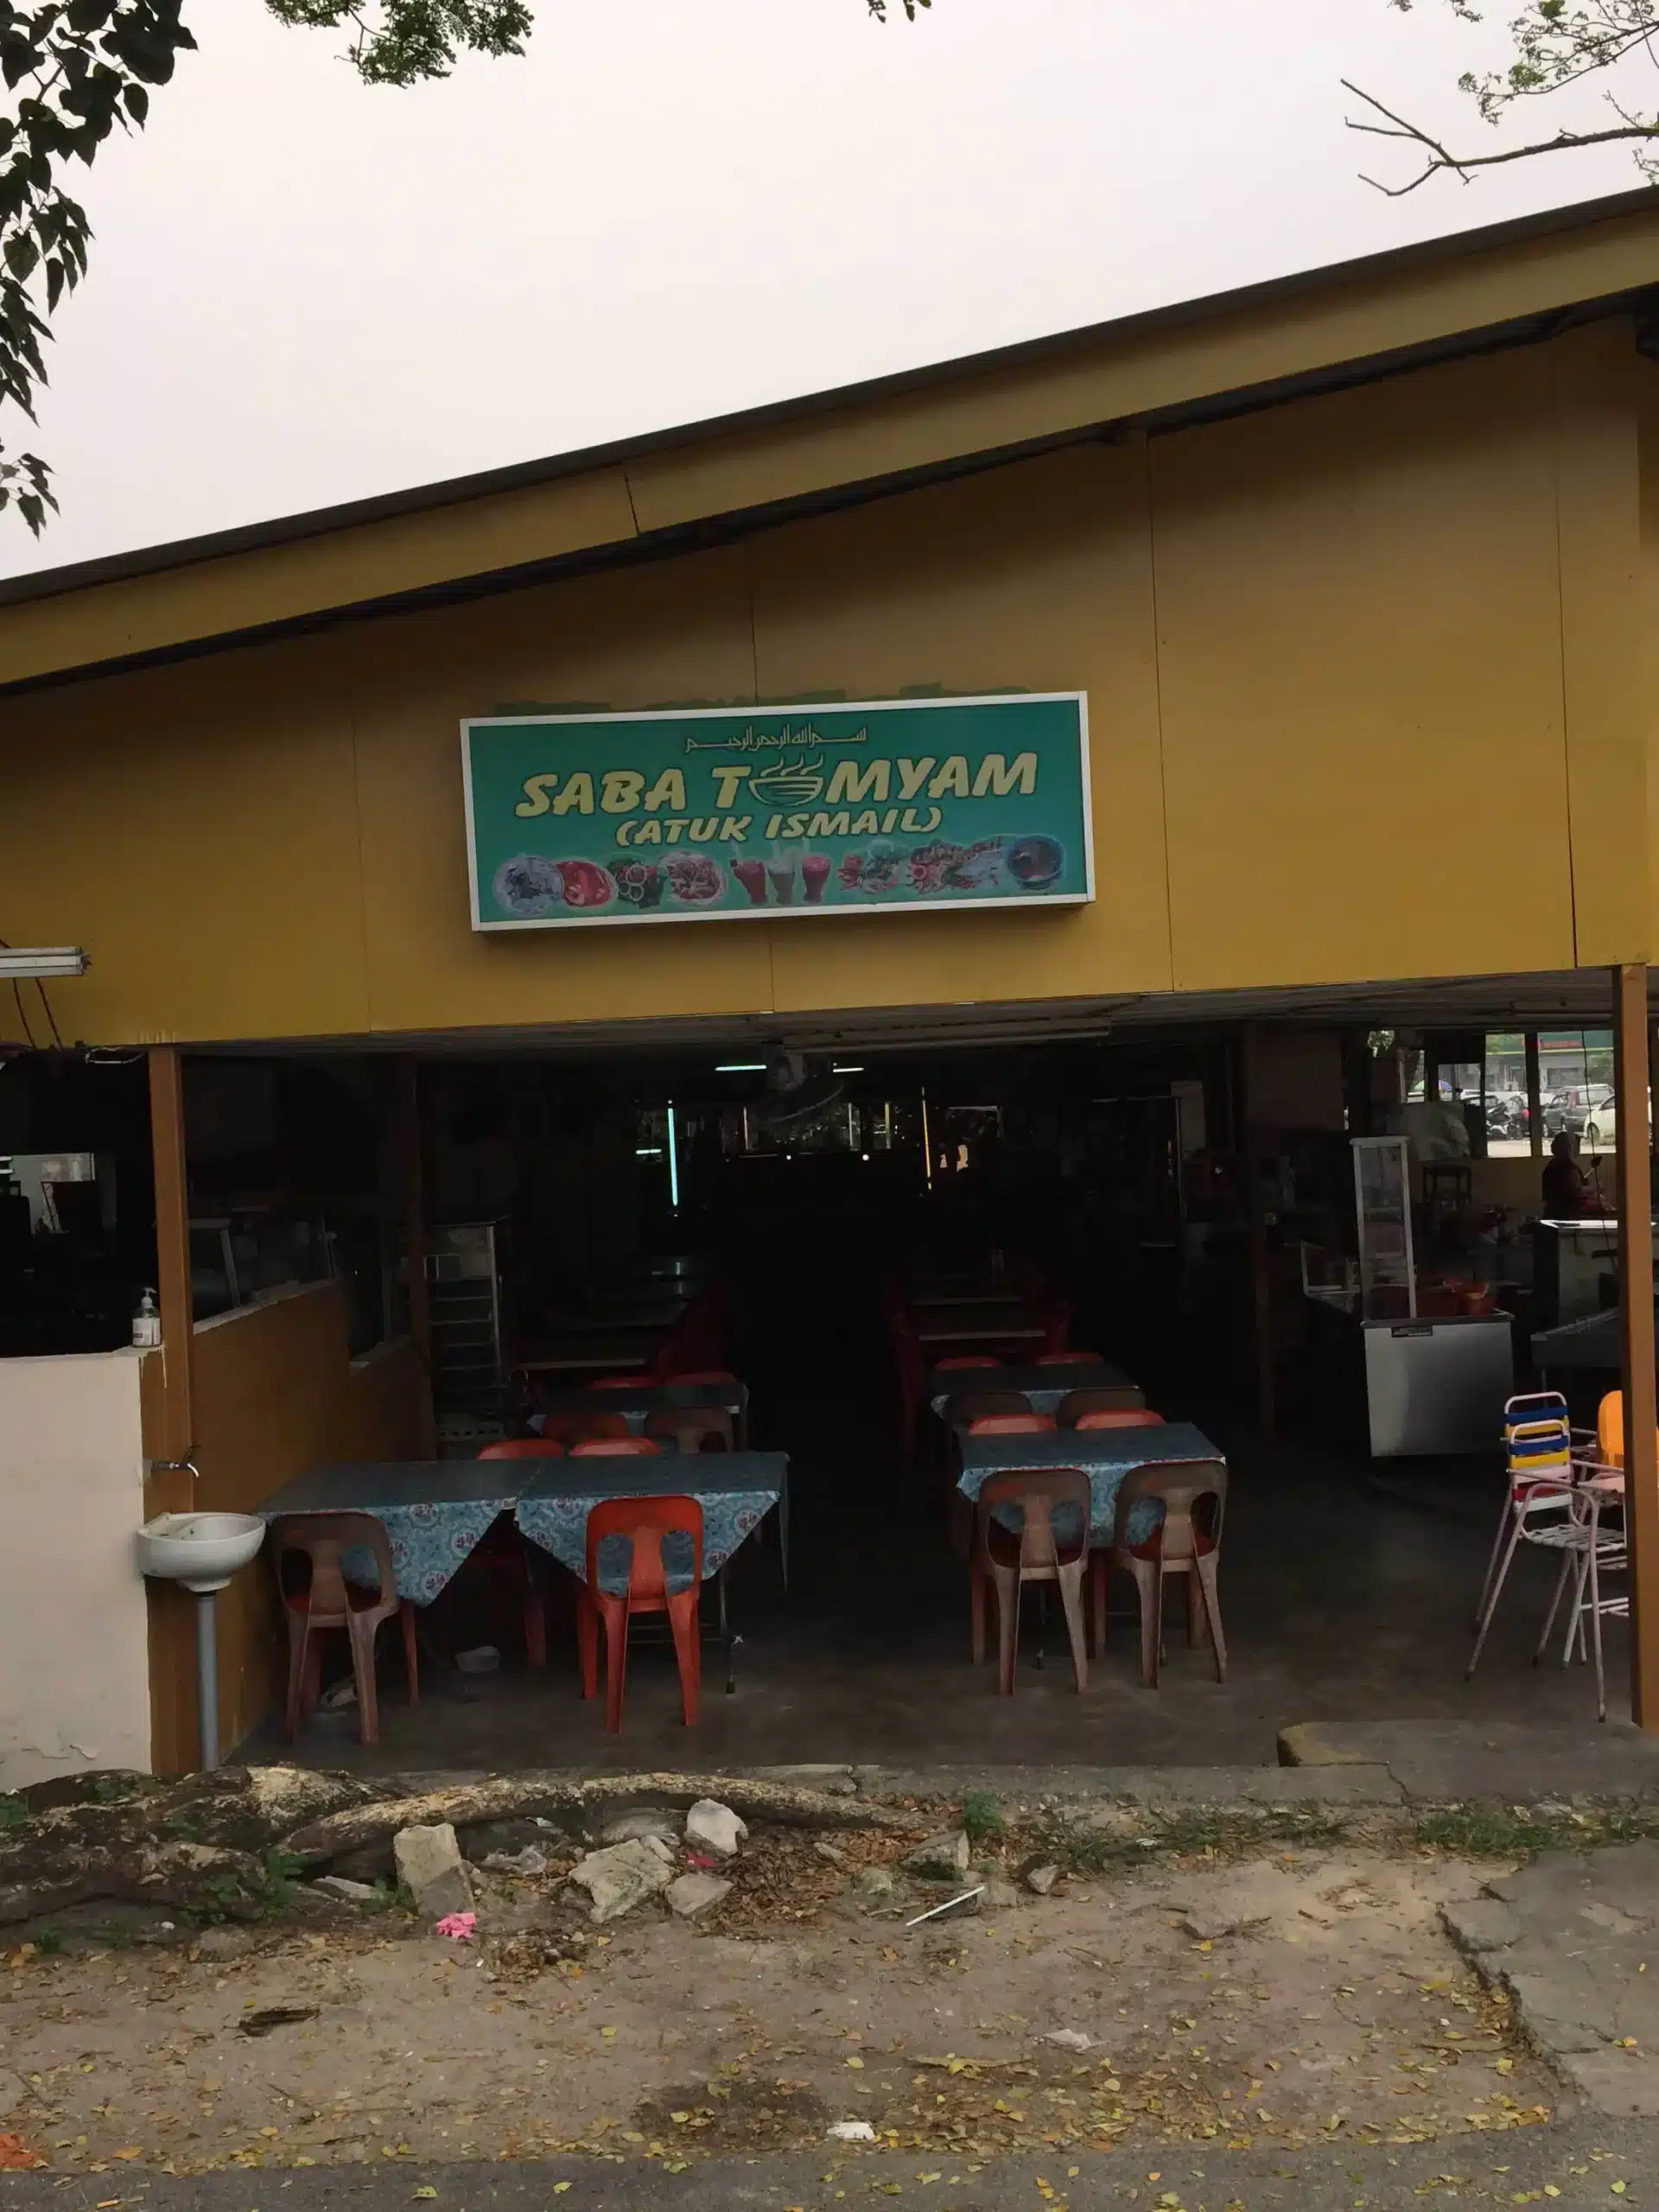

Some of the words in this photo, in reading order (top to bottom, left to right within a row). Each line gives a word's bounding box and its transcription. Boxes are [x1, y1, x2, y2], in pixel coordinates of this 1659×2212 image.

[514, 767, 687, 818] SABA
[614, 815, 753, 847] (ATUK
[764, 805, 944, 840] ISMAIL)
